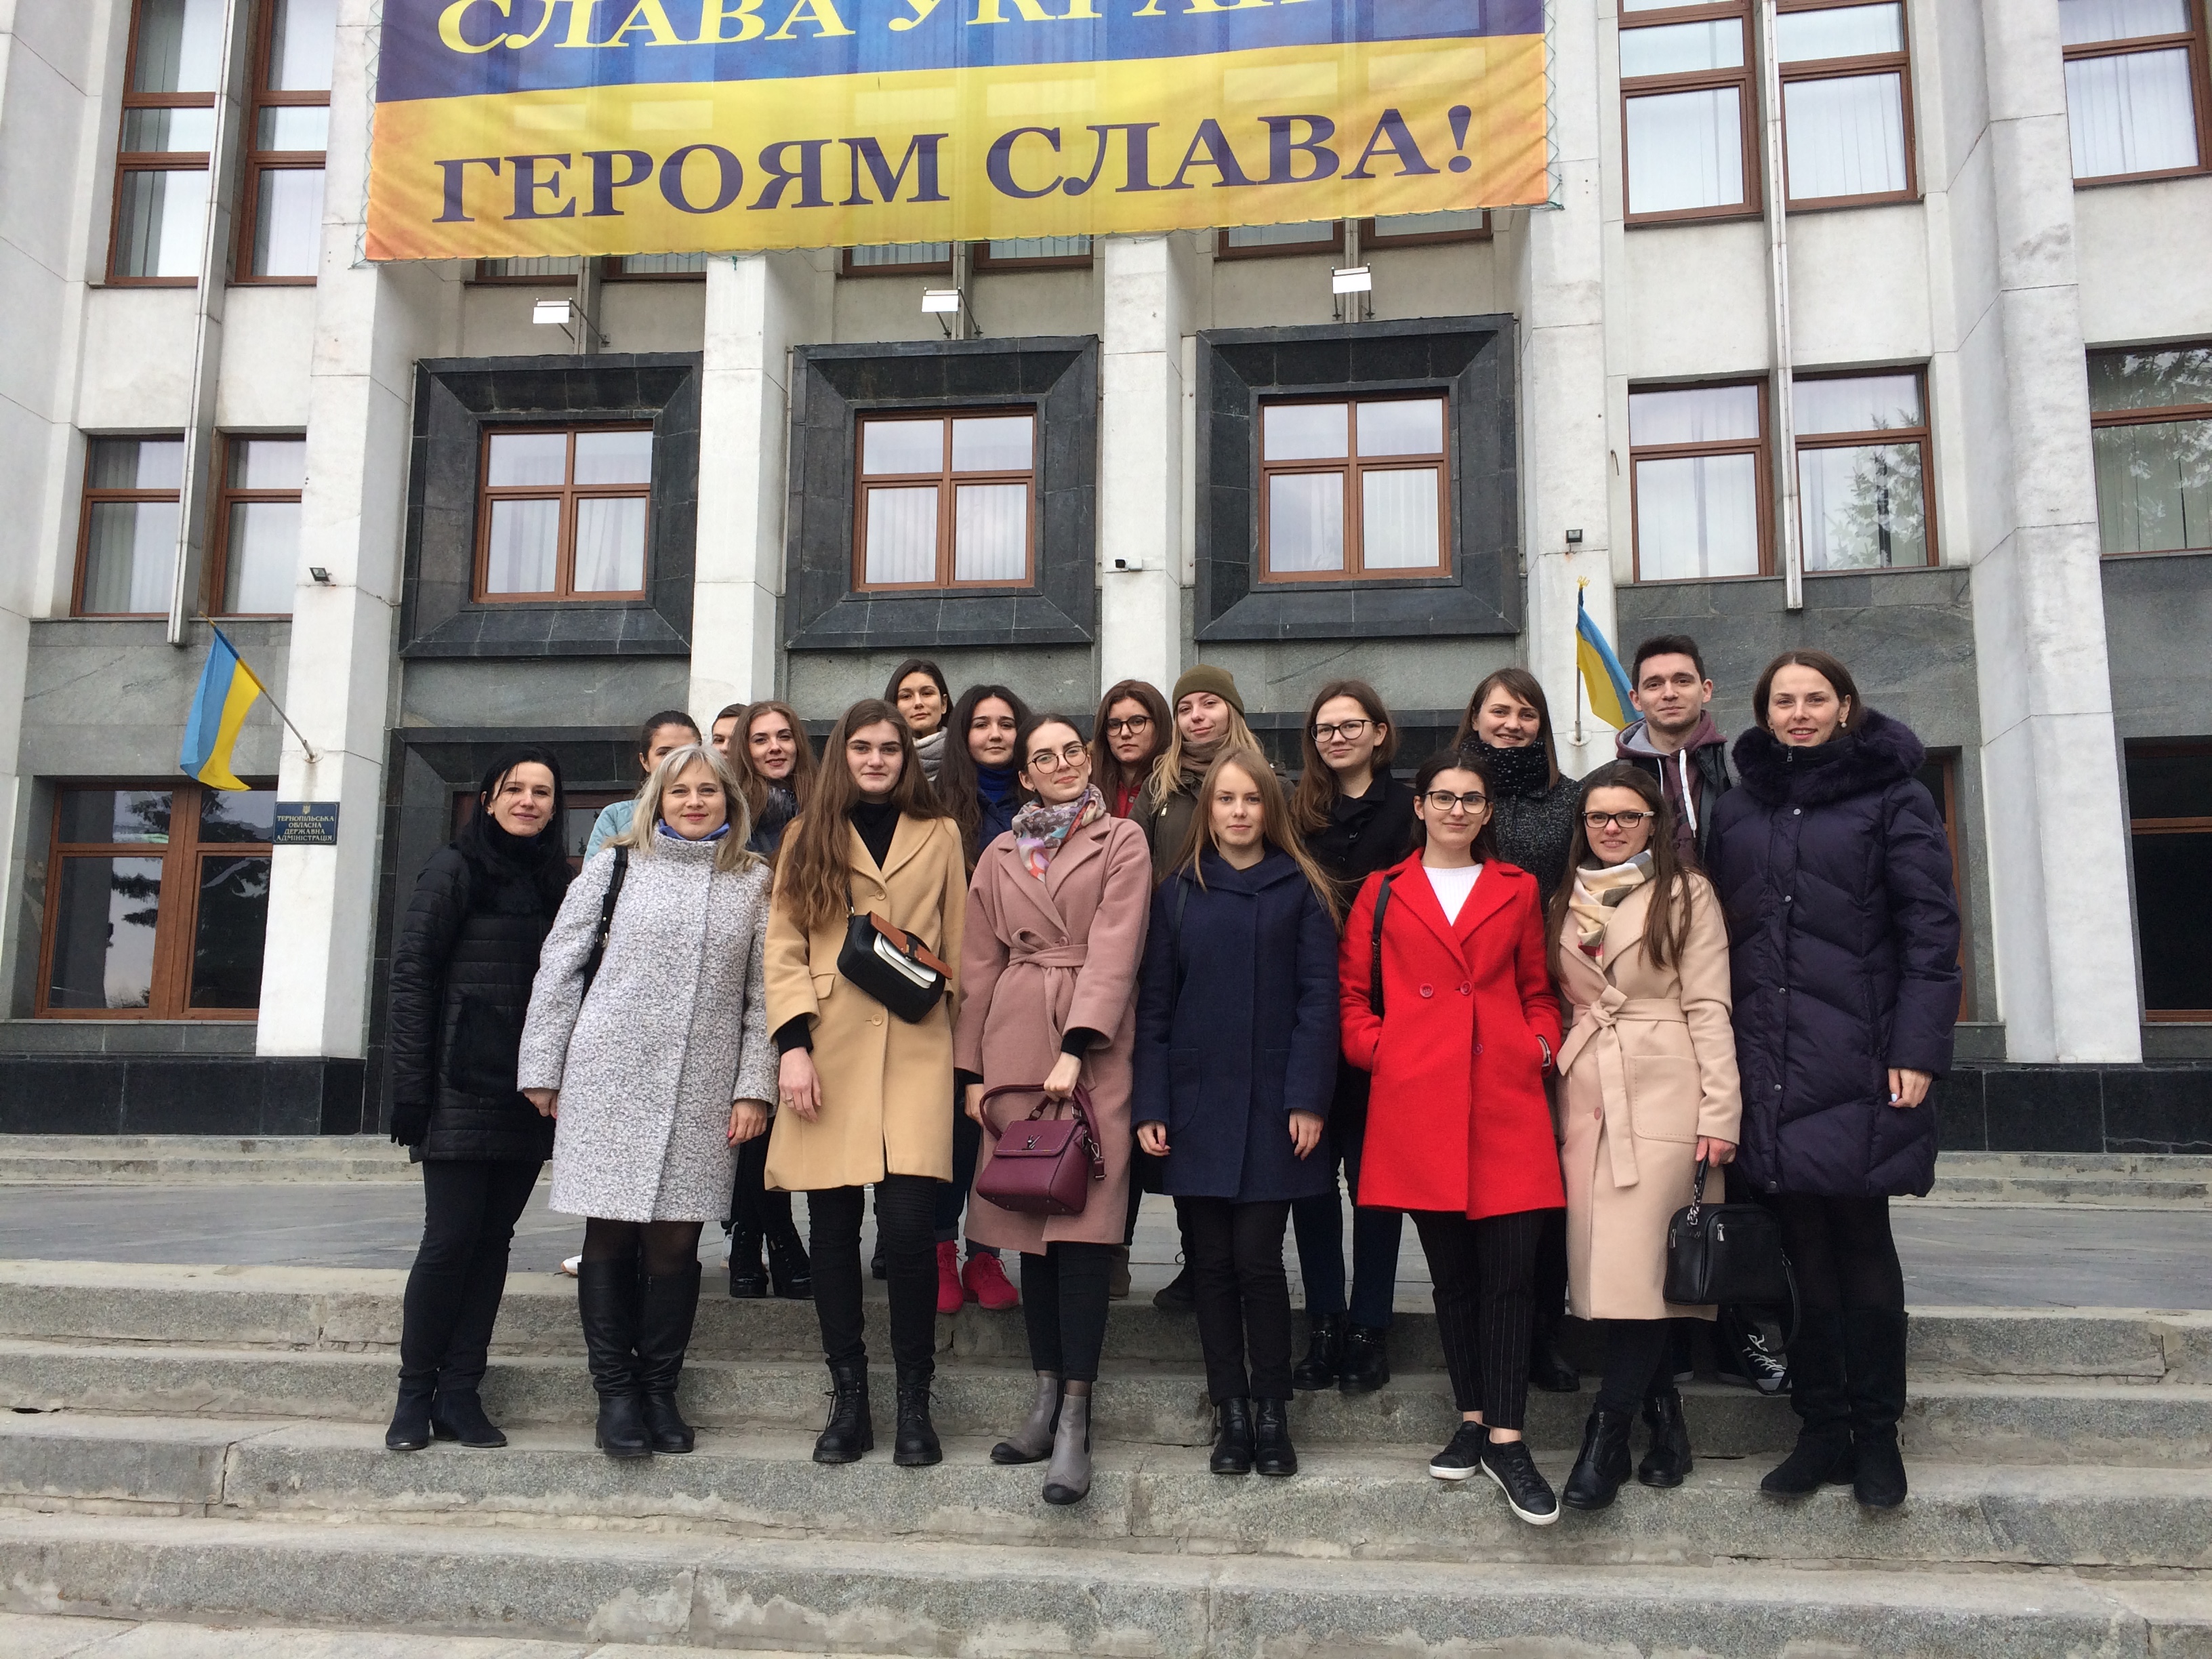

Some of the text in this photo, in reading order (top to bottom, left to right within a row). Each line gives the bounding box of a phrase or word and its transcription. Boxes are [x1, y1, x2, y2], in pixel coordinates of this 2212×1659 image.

[437, 0, 856, 54] СЛАВА
[432, 105, 1473, 224] ГЕРОЯМ СЛАВА!
